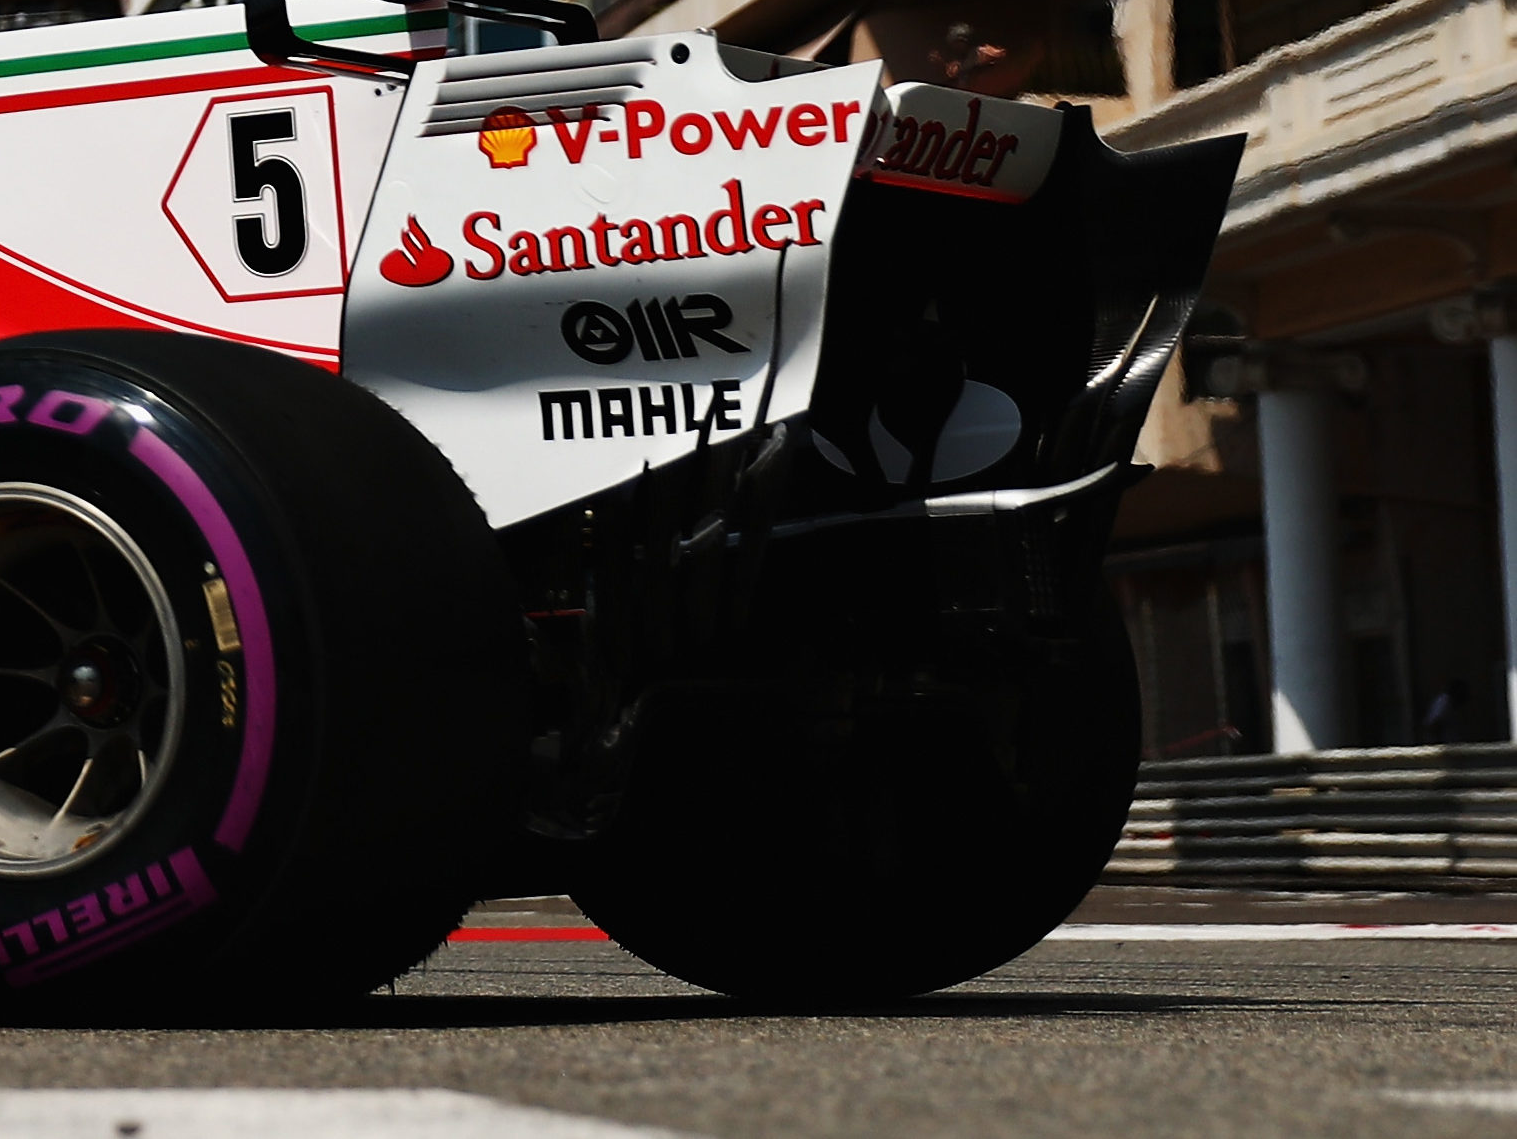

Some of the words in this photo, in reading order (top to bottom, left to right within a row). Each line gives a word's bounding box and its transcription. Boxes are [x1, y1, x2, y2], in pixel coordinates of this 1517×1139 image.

[545, 99, 861, 164] V-Power
[227, 107, 308, 278] 5
[462, 178, 826, 280] Santander
[538, 379, 742, 441] MAHLE
